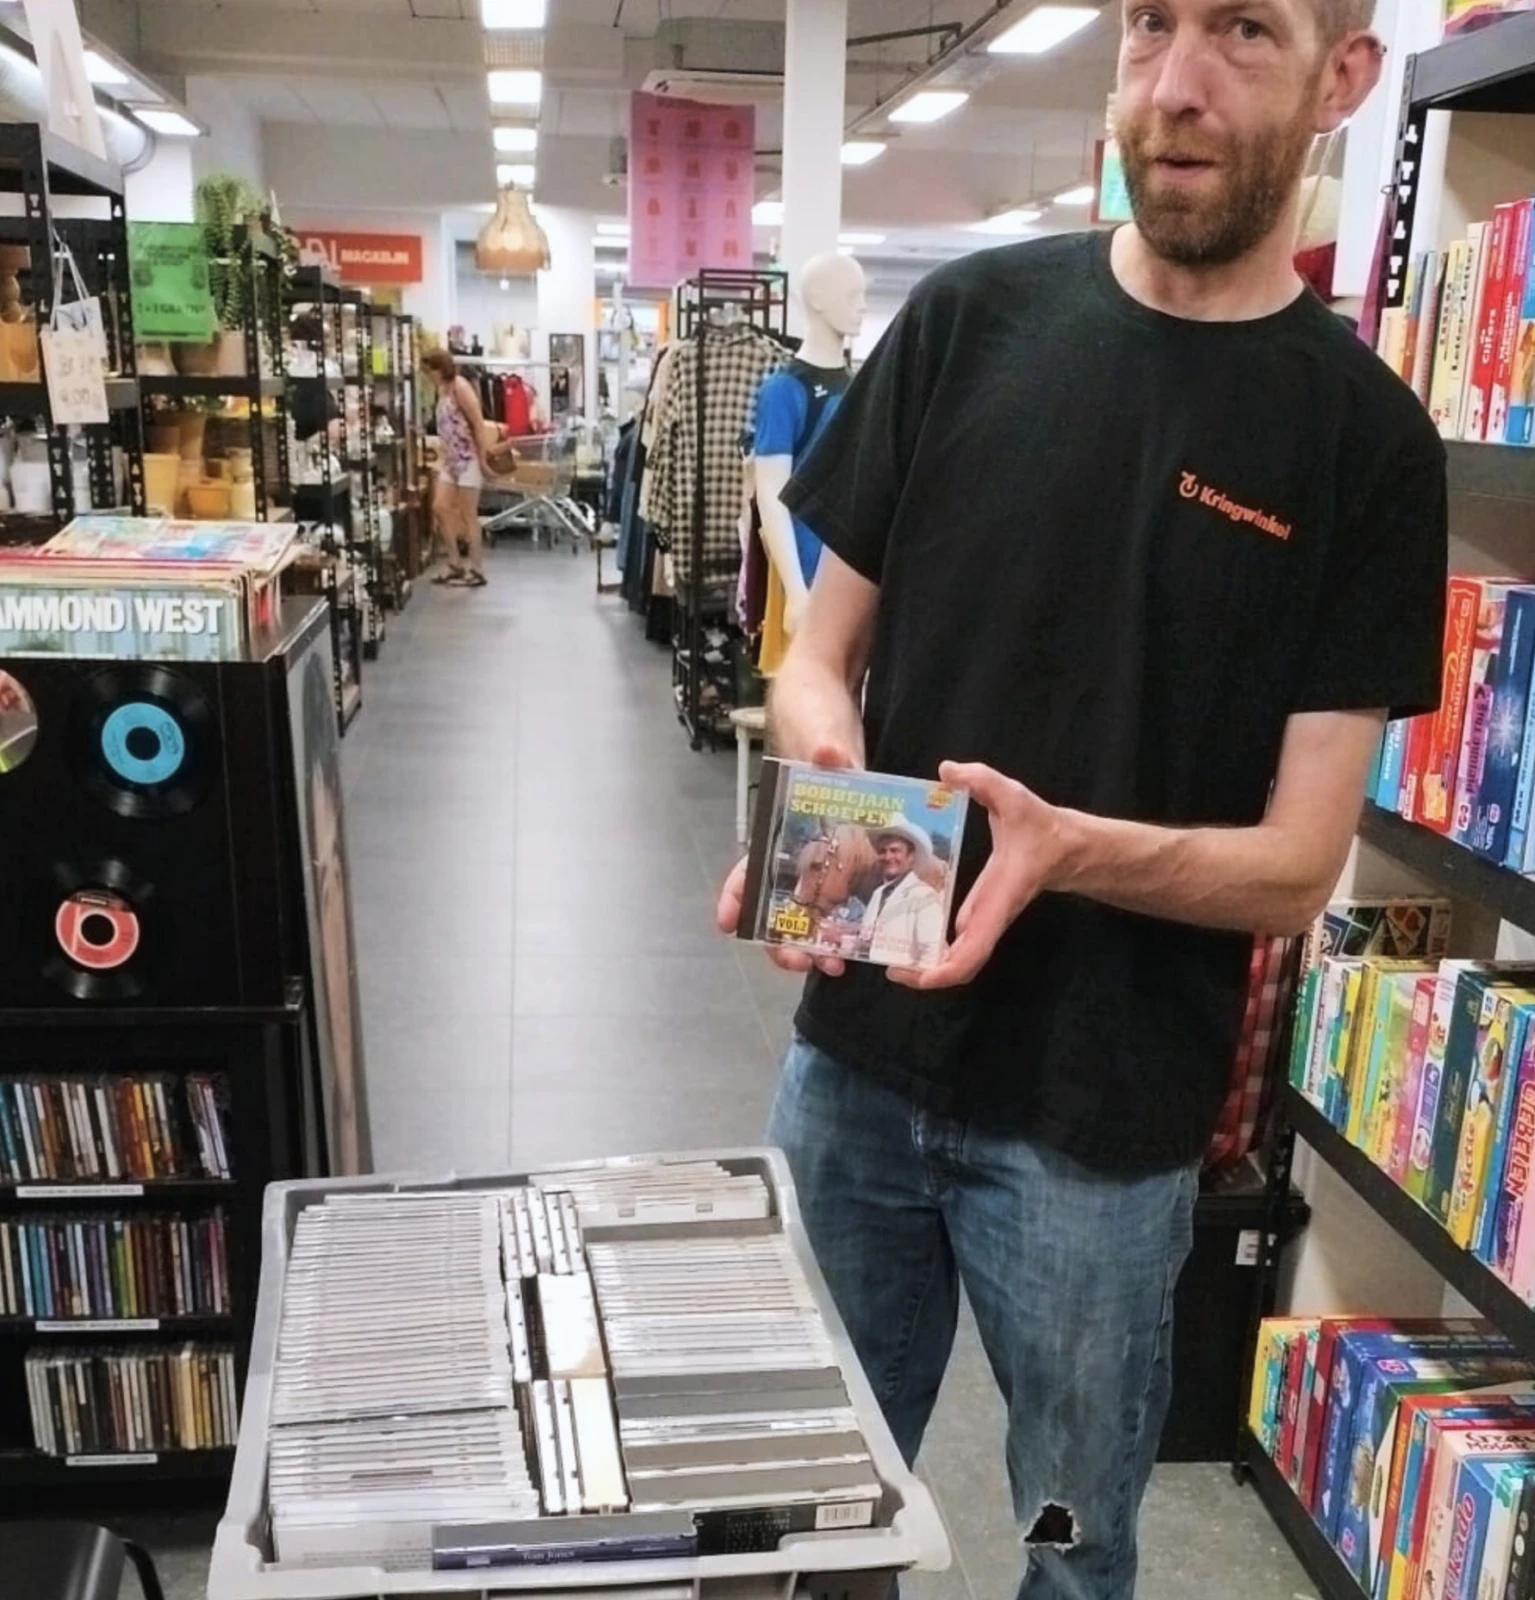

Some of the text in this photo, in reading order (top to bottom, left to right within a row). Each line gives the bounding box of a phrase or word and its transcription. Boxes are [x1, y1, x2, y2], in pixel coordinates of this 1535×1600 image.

[1198, 486, 1292, 540] Kringwinkel
[133, 597, 224, 635] WEST
[1464, 735, 1480, 794] PICTURE
[790, 799, 890, 829] SCHOEPEN
[792, 783, 905, 812] BOBBEJAAN
